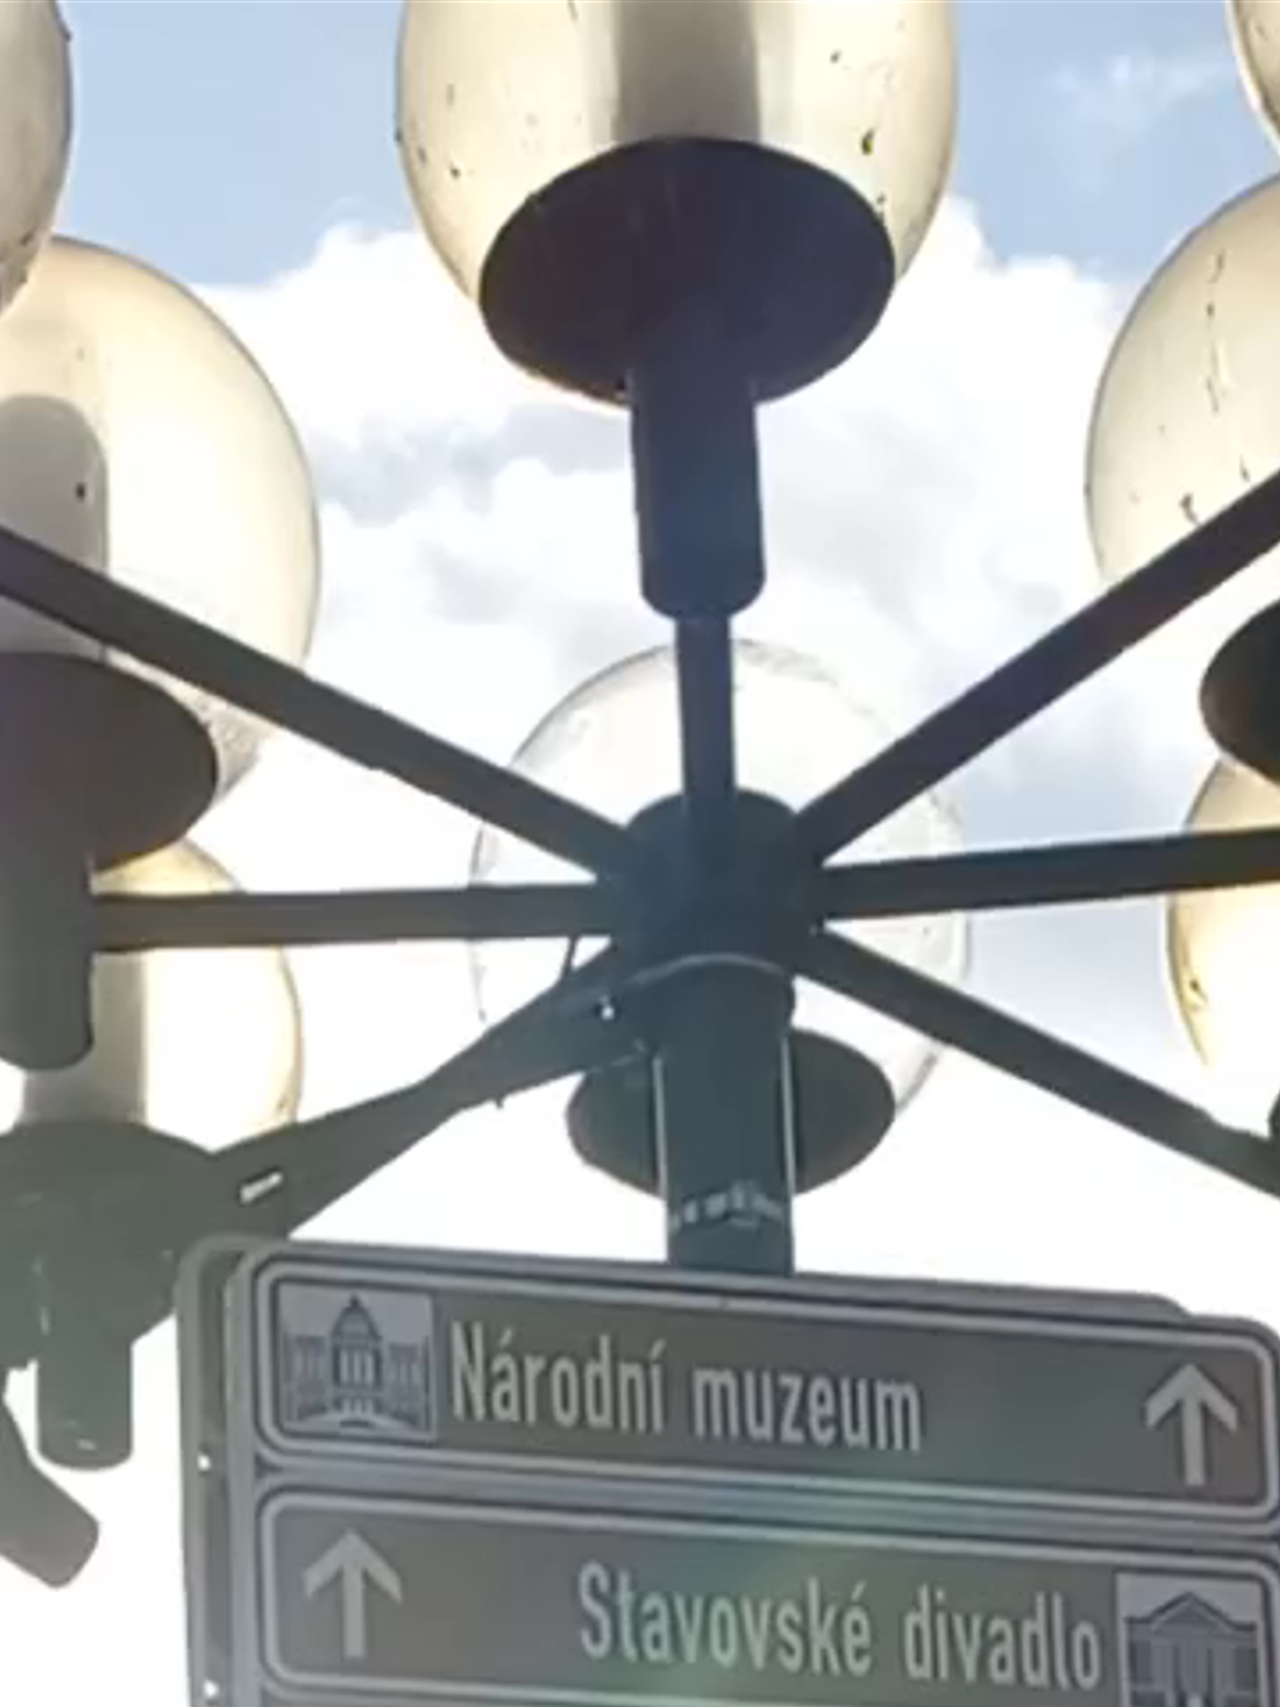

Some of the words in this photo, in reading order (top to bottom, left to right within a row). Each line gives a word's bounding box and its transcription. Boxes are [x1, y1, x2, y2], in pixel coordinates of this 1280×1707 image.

[450, 1320, 664, 1438] Národní
[693, 1368, 923, 1452] muzeum
[579, 1559, 873, 1680] Stavovské
[904, 1583, 1102, 1694] divadlo
